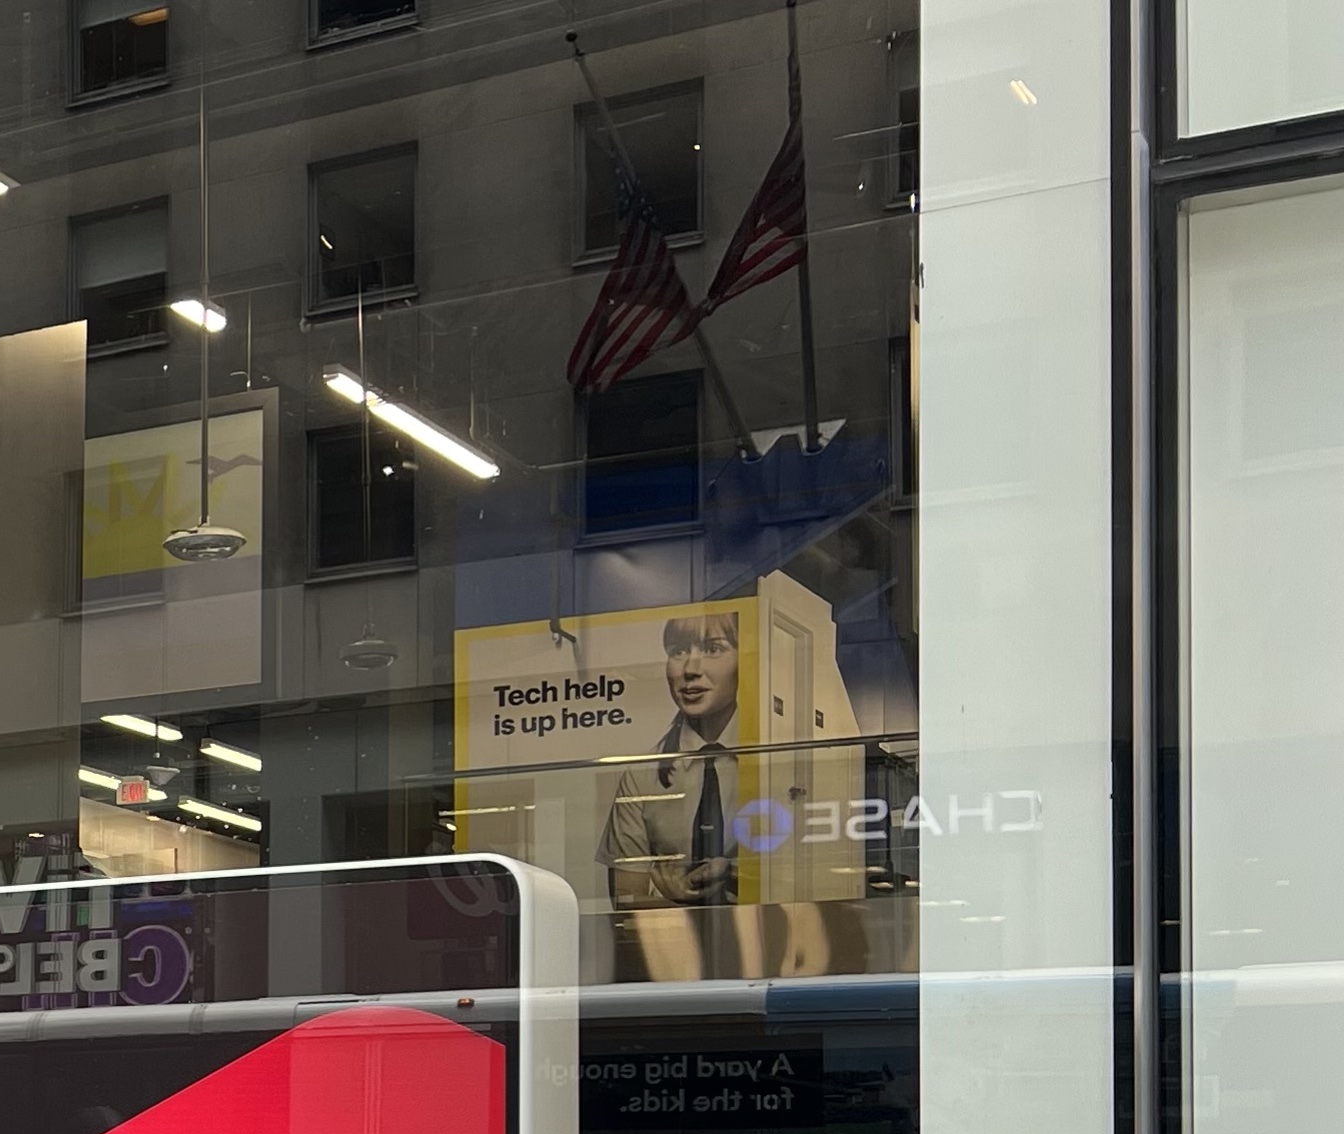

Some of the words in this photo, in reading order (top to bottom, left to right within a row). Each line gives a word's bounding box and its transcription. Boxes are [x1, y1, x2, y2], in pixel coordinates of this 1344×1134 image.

[493, 681, 558, 707] Tech
[564, 675, 625, 701] help
[494, 714, 515, 736] is
[521, 715, 556, 737] up
[562, 708, 632, 730] here.
